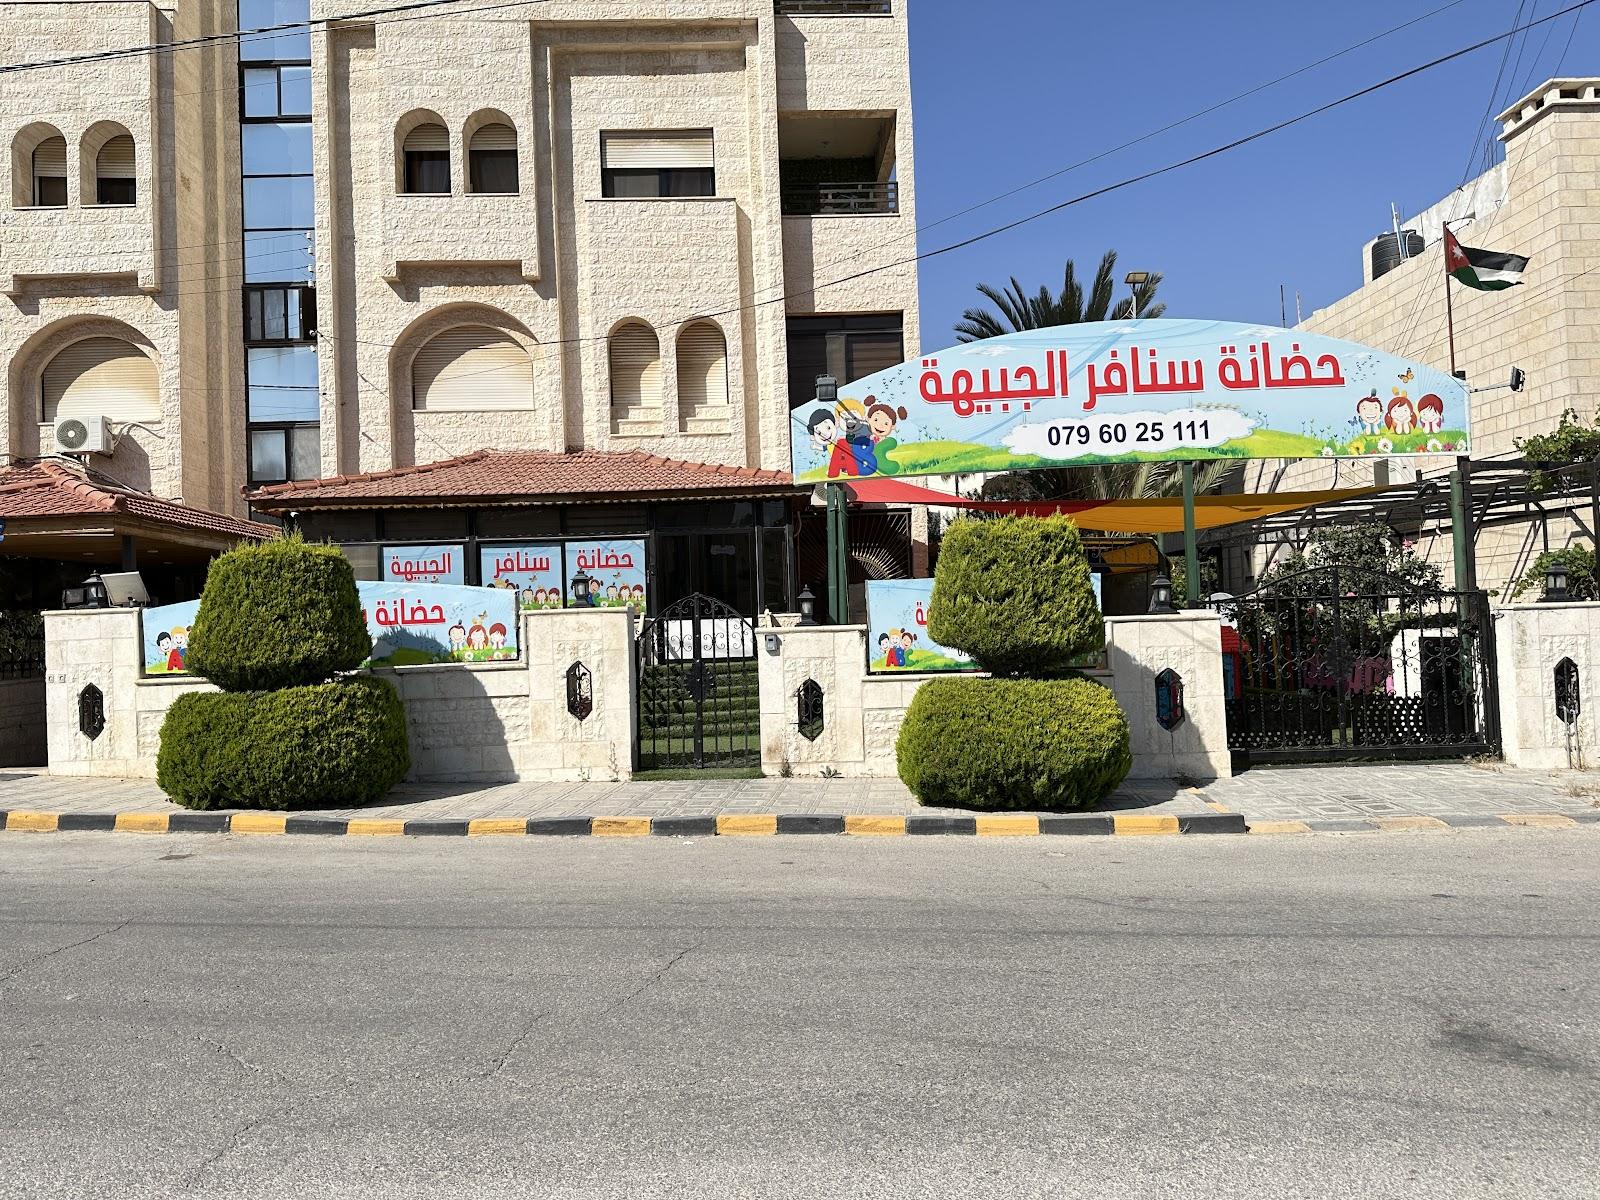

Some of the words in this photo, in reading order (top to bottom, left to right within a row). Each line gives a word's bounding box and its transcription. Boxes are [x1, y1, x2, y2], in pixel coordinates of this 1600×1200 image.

[1084, 347, 1204, 410] سنافر
[1219, 343, 1345, 389] حضانة
[920, 350, 1068, 417] الجبيهة
[1047, 424, 1090, 446] 079
[1099, 423, 1127, 445] 60
[1136, 422, 1164, 442] 25
[1174, 420, 1209, 441] 111
[827, 436, 901, 479] ABC
[391, 552, 452, 581] الجبيهة
[494, 551, 550, 579] سنافر
[577, 548, 633, 569] حضانة
[375, 598, 446, 626] حضانة
[886, 647, 915, 667] ABC
